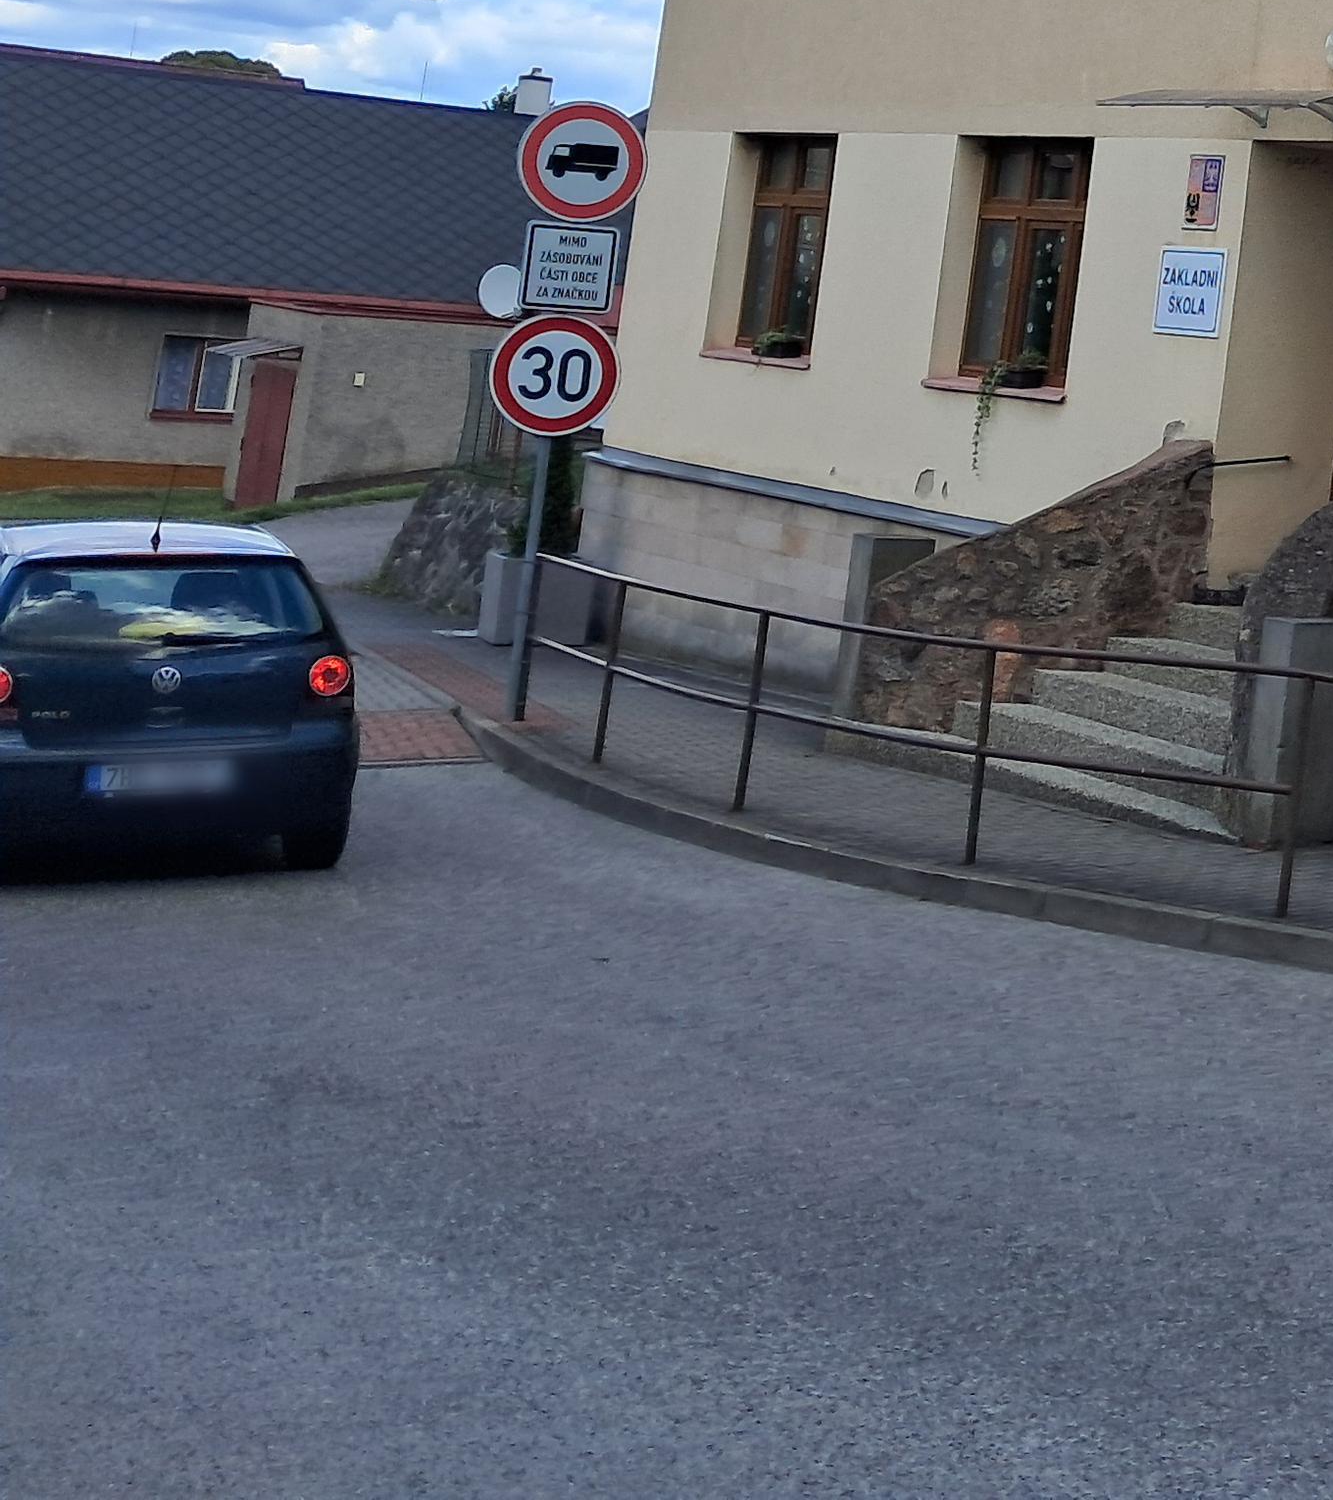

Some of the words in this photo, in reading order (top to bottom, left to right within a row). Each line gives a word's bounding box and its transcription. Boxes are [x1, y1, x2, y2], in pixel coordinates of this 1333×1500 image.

[559, 235, 588, 248] MIMO
[539, 249, 604, 267] ZÁSOBOVÁNÍ
[539, 266, 569, 281] ČÁSTI
[571, 270, 599, 284] OBCE
[535, 285, 549, 298] ZA
[550, 285, 599, 302] ZNAČKOU
[1167, 290, 1206, 315] ŠKOLA
[517, 346, 592, 402] 30
[31, 709, 72, 720] POLO
